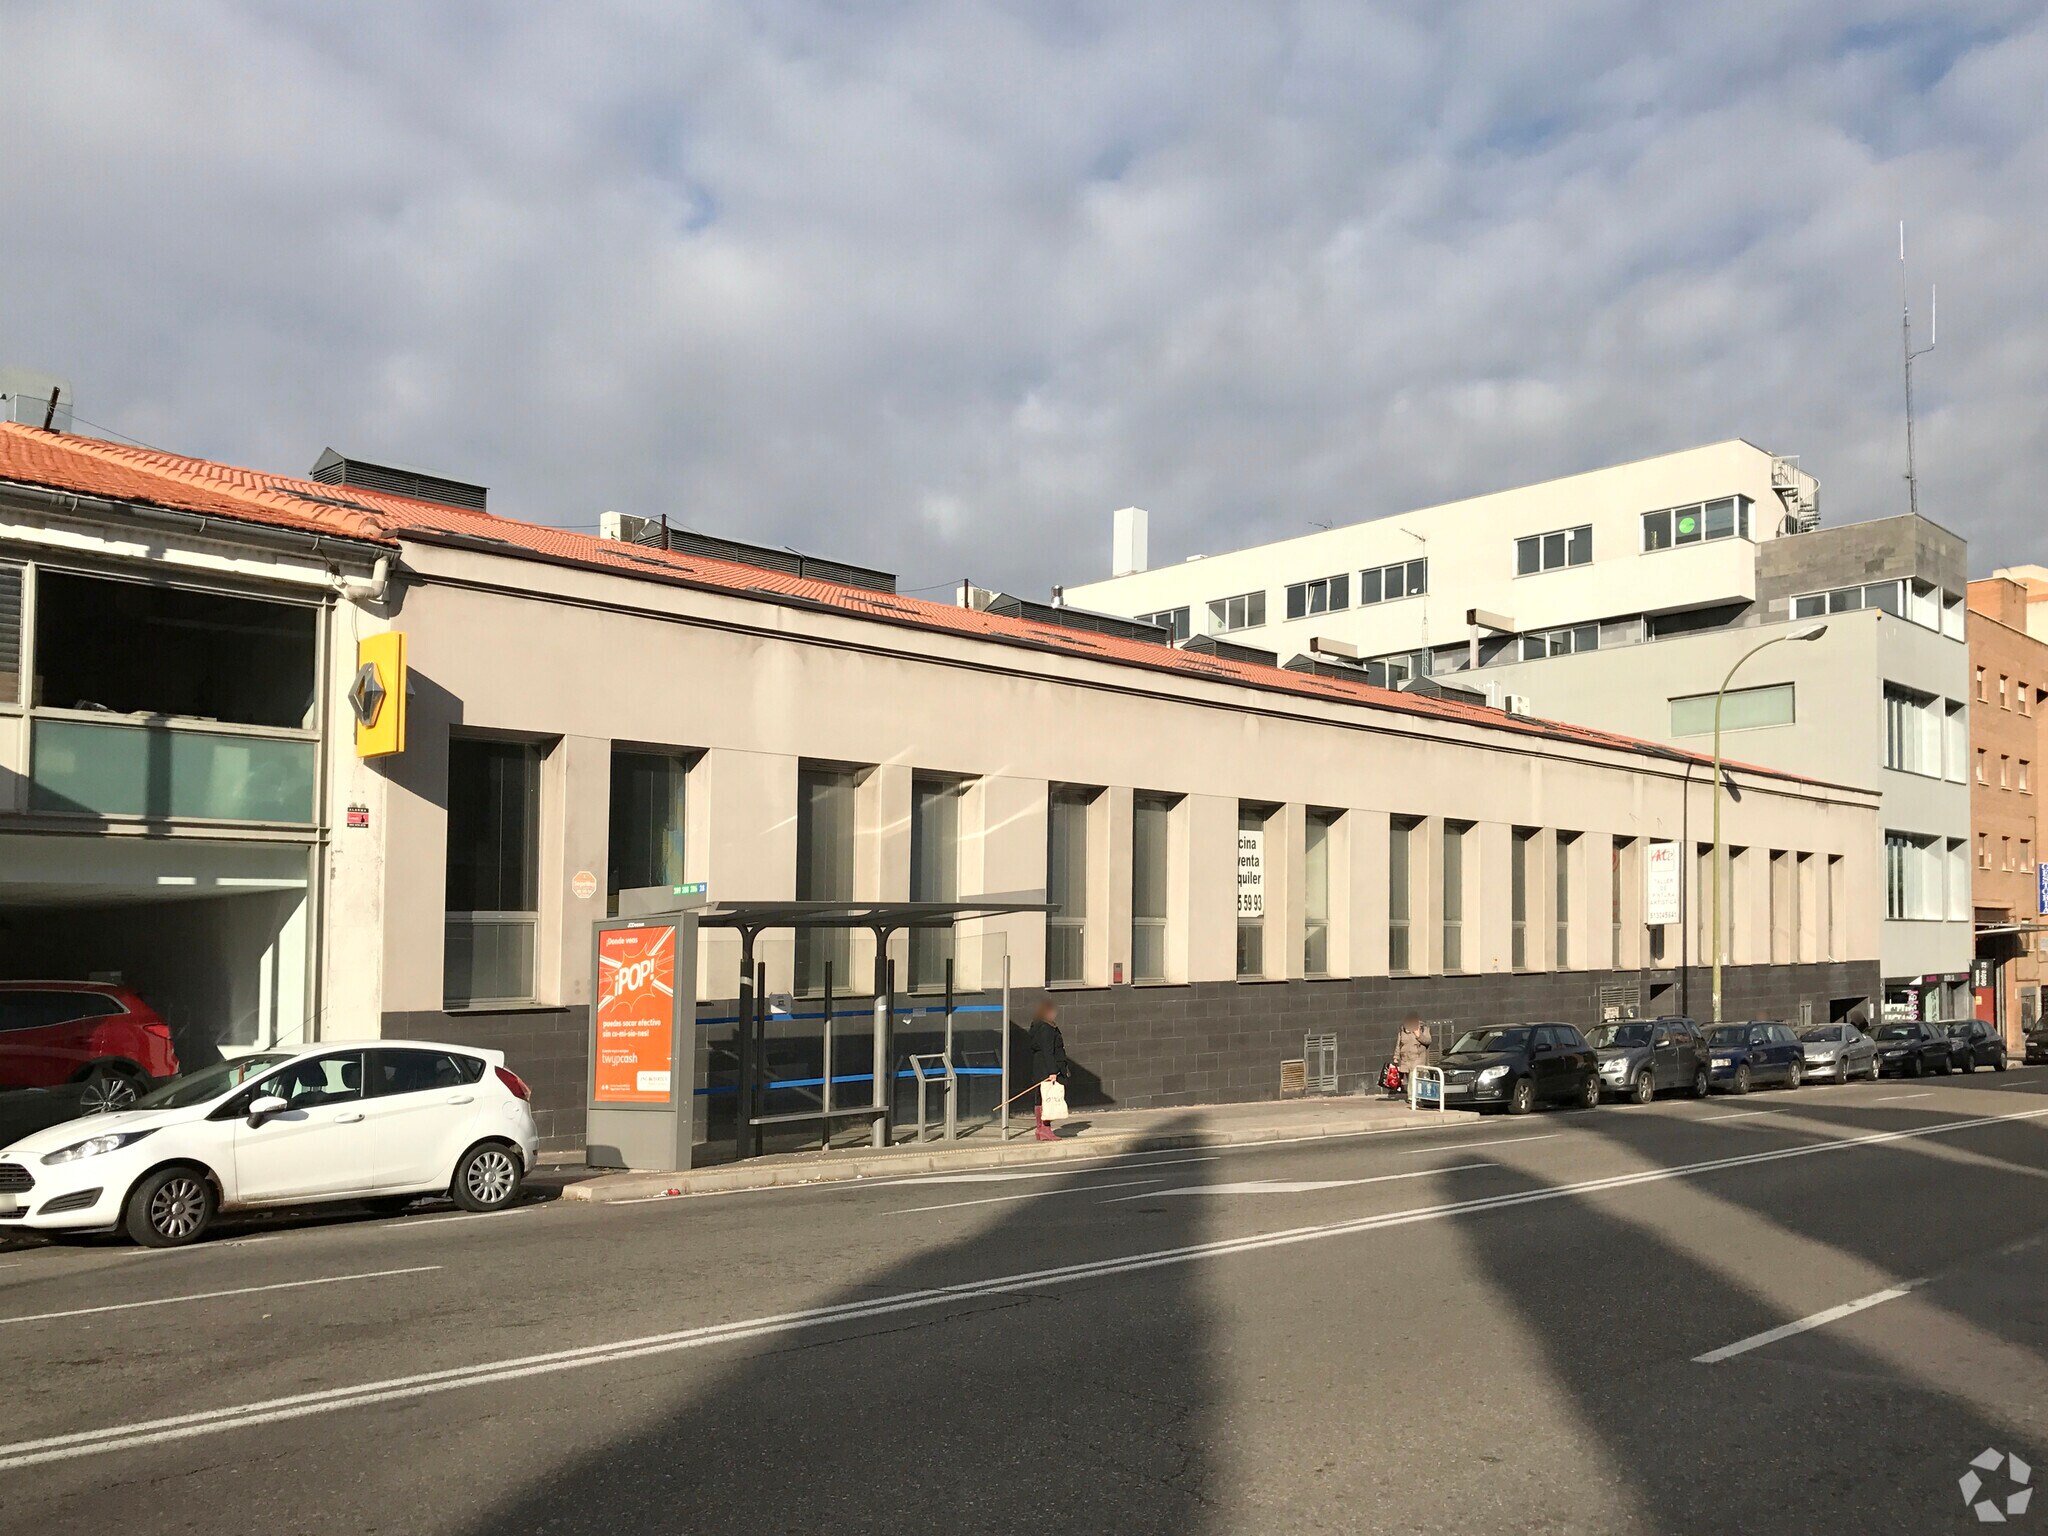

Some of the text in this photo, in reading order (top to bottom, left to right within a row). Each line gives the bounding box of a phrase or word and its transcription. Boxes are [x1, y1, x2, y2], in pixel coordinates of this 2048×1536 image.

[1243, 894, 1252, 911] 59
[1253, 894, 1262, 911] 93
[615, 957, 655, 997] ¡POP!
[603, 1019, 622, 1029] puedes
[637, 1018, 661, 1026] efectivo
[602, 1053, 638, 1067] twypcash
